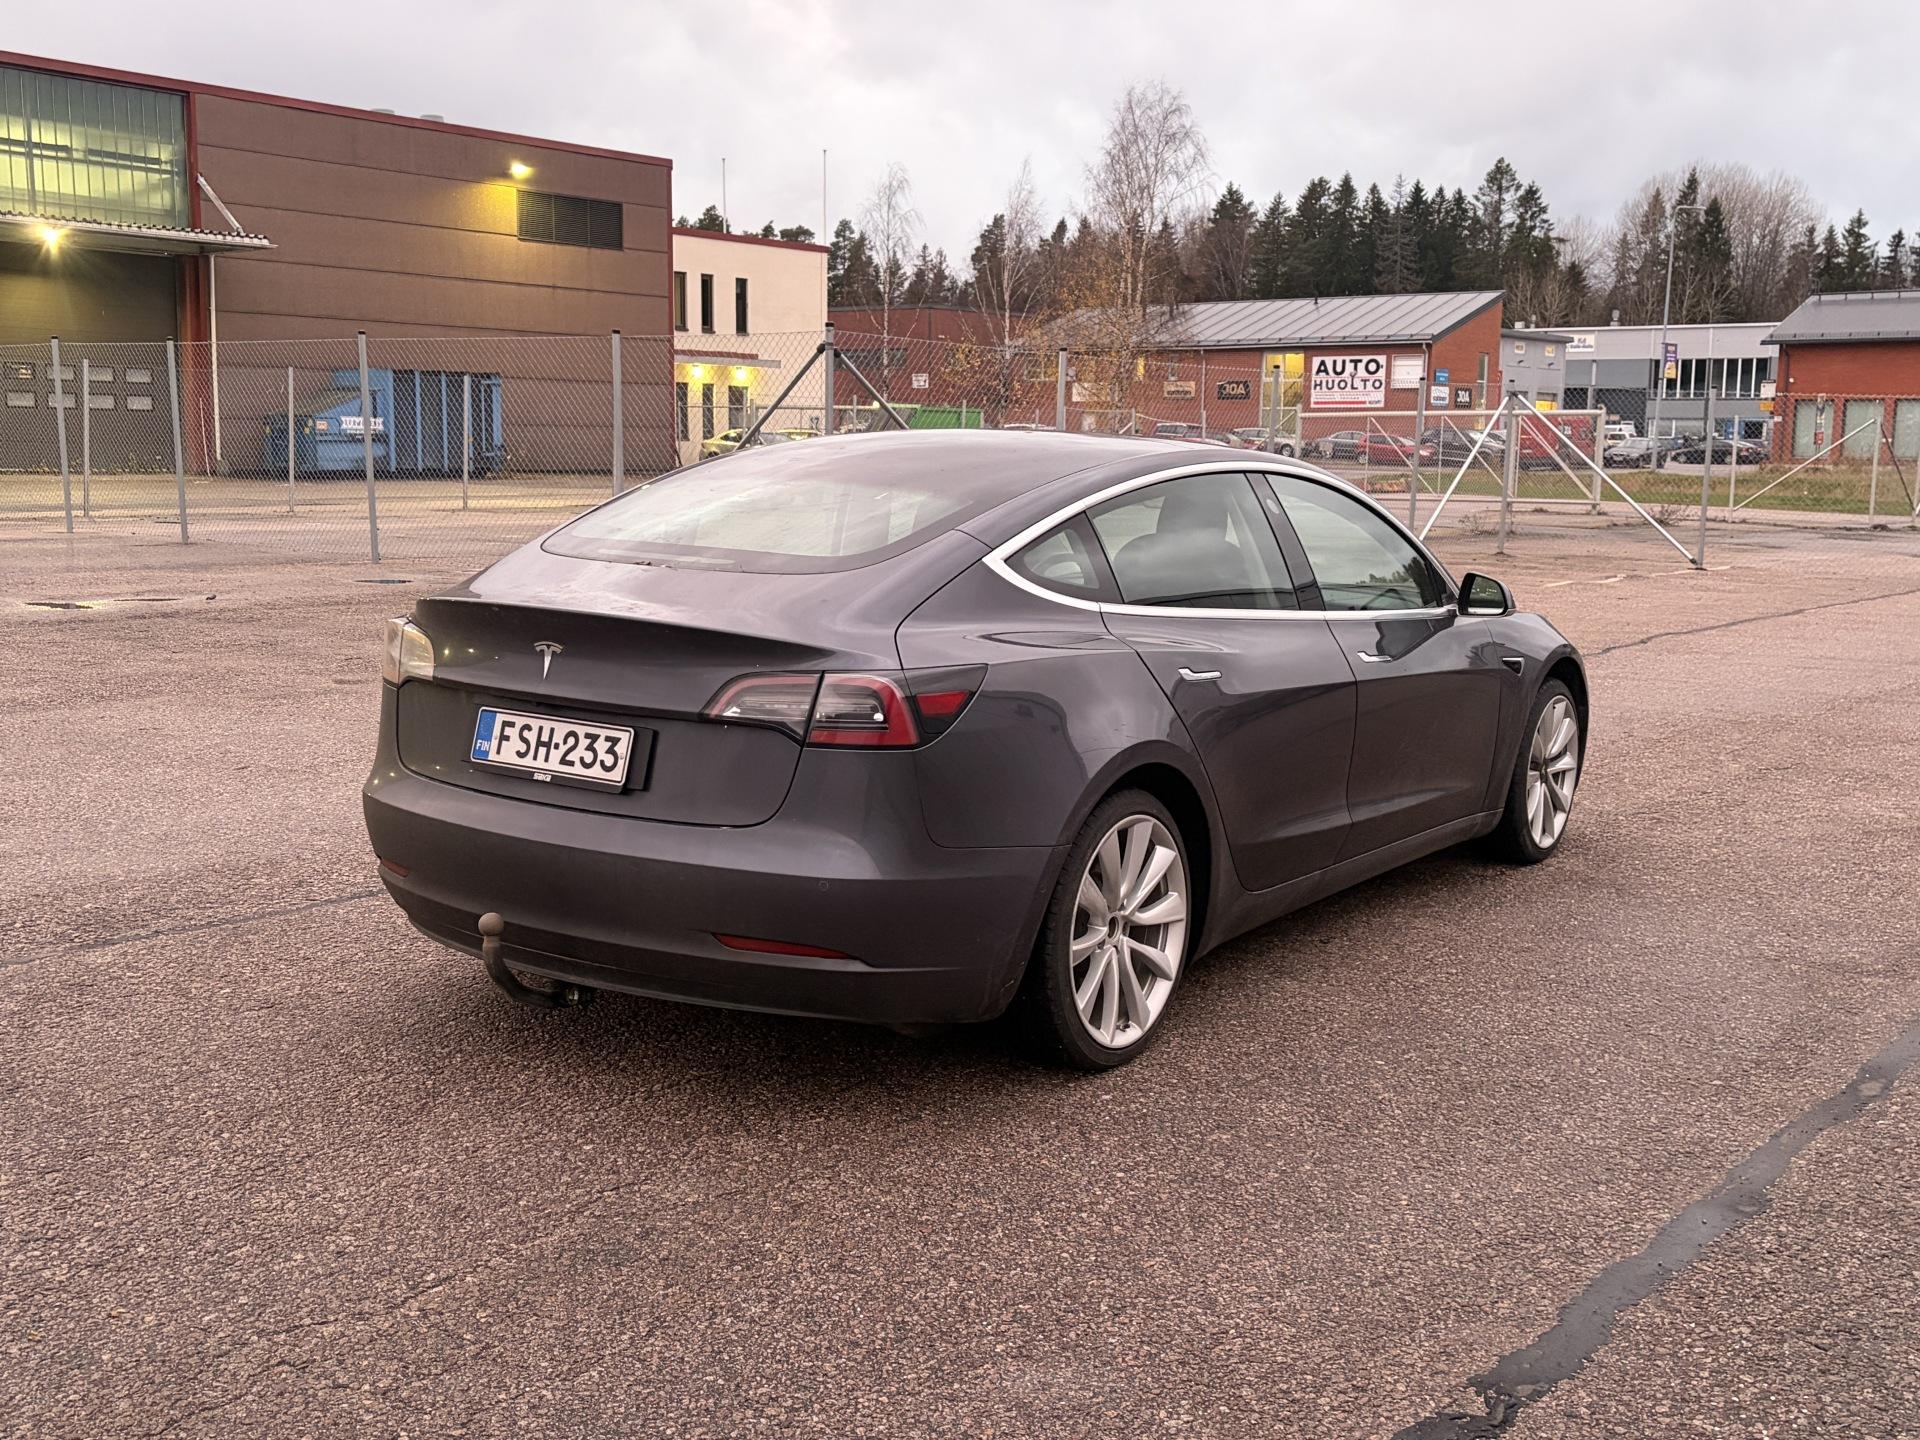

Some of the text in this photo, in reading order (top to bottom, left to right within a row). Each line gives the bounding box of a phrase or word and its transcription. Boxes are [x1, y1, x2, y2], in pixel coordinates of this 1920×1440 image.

[1313, 379, 1383, 390] HUOLTO
[476, 739, 490, 752] FIN
[496, 720, 622, 772] FSH-233
